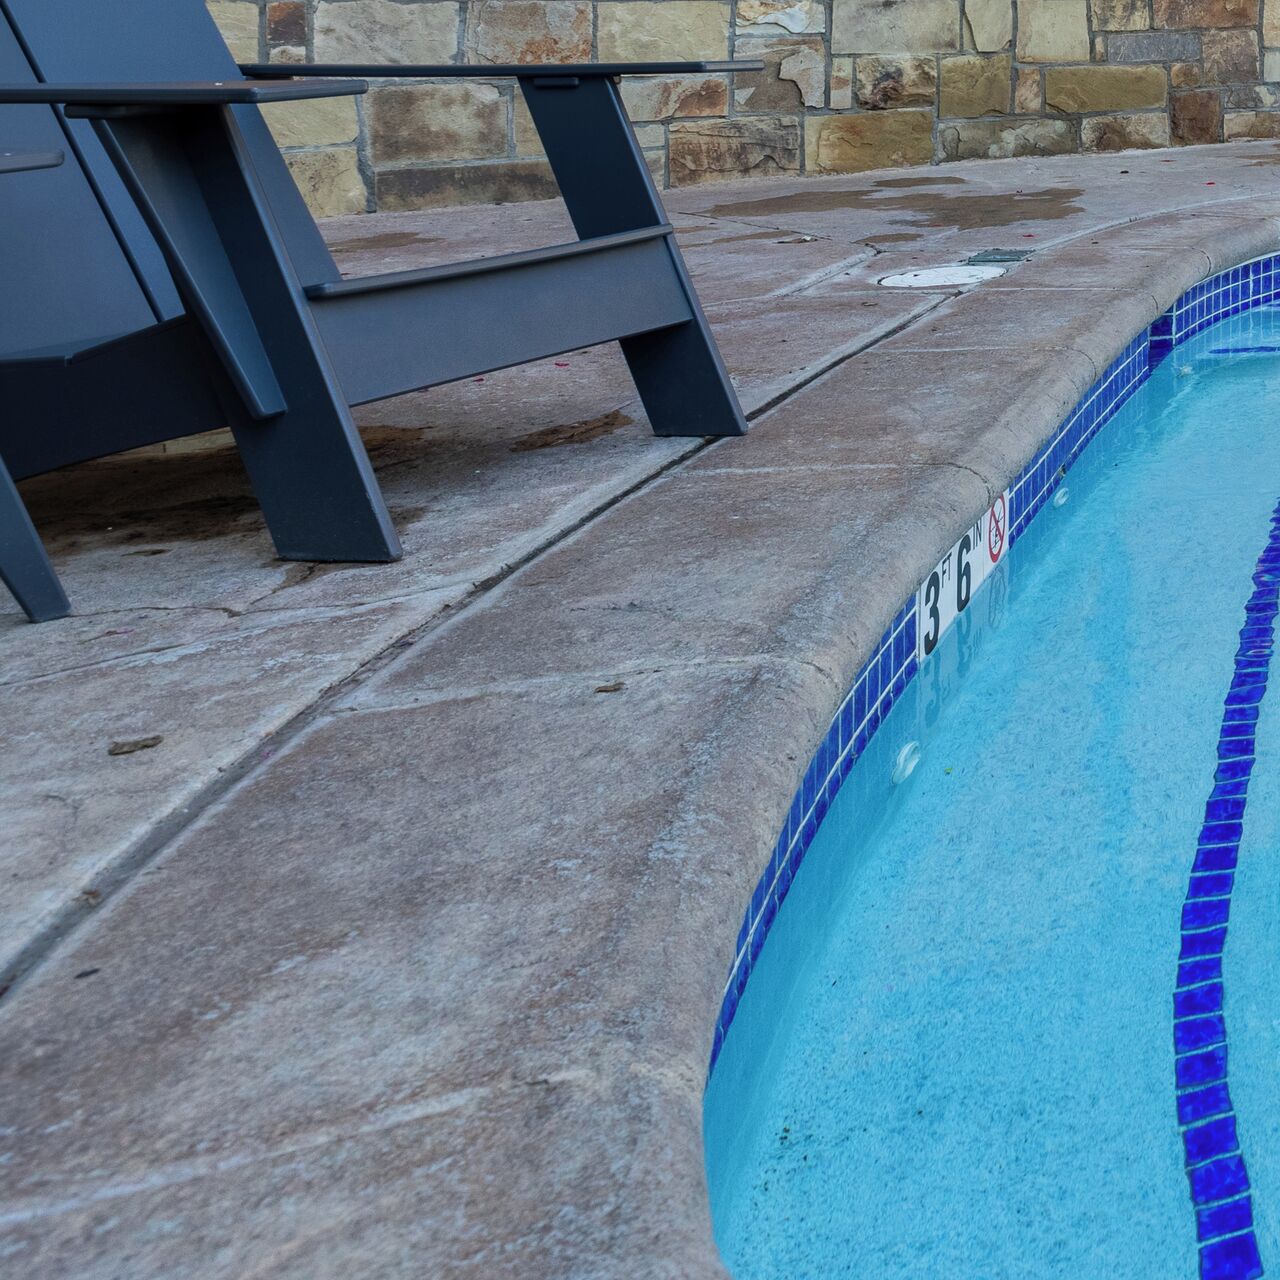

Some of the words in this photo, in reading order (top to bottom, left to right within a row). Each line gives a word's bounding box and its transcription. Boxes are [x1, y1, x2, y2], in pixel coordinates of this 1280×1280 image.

[924, 571, 940, 656] 3
[941, 552, 952, 587] FT
[956, 534, 971, 613] 6
[973, 517, 983, 550] IN
